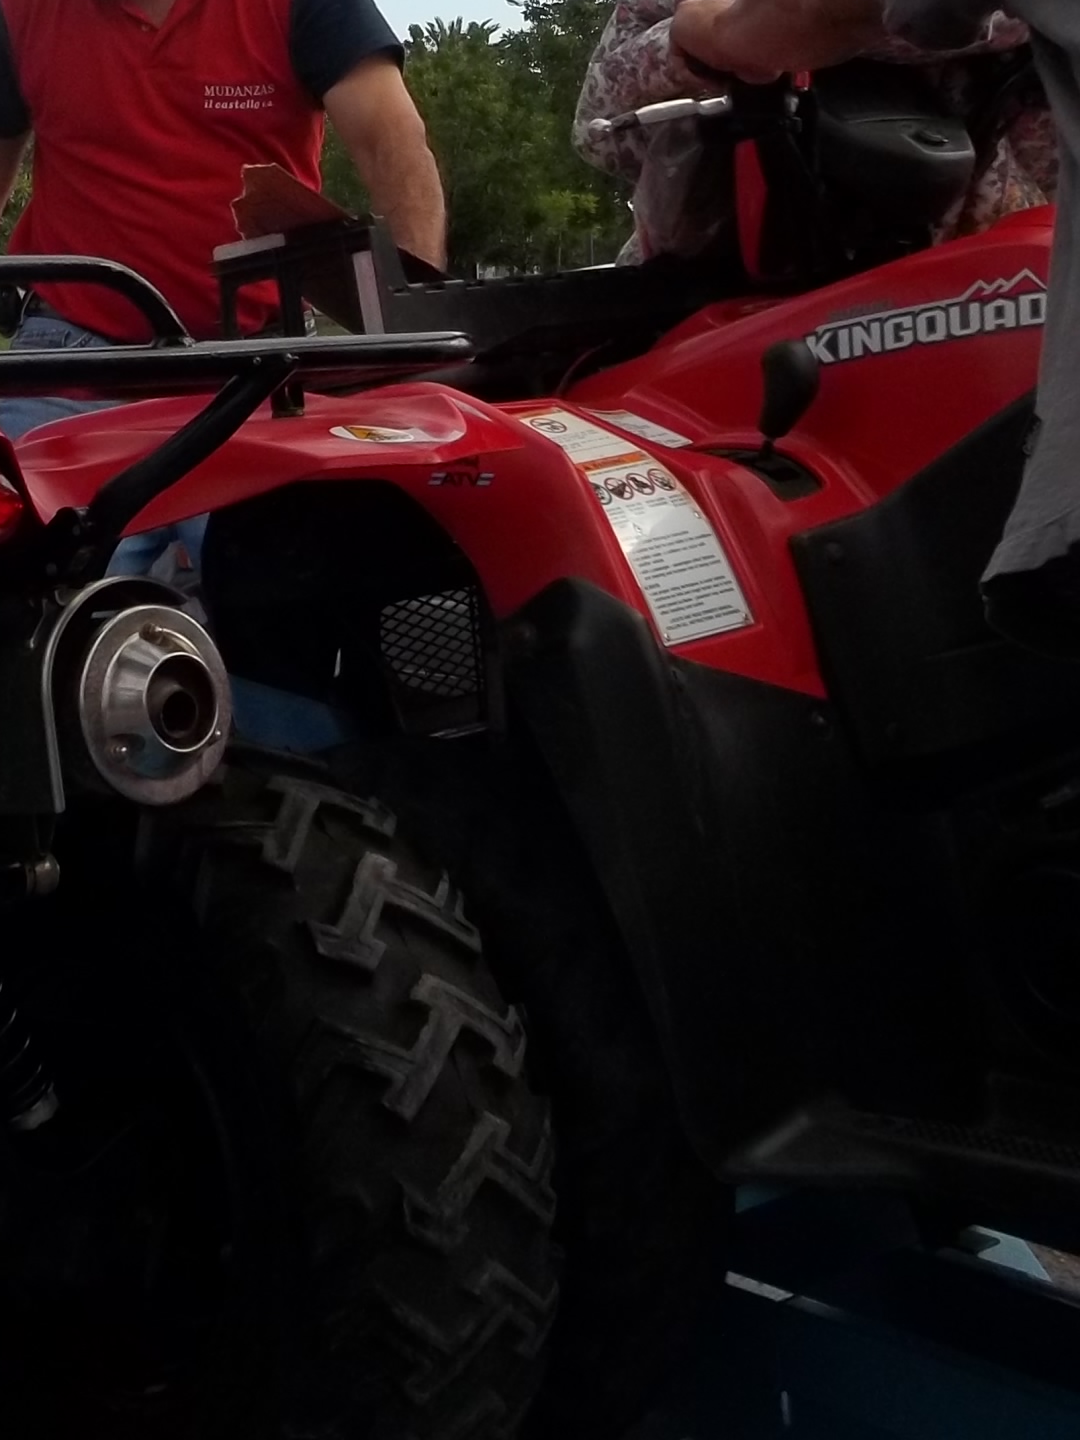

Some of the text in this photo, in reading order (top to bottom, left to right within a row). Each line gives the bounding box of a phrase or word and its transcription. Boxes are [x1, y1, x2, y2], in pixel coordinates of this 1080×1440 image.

[203, 83, 276, 97] MUDANZAS
[204, 99, 213, 109] il
[215, 98, 261, 110] castello
[805, 292, 1048, 364] KINGQUAD
[440, 471, 482, 488] ATV
